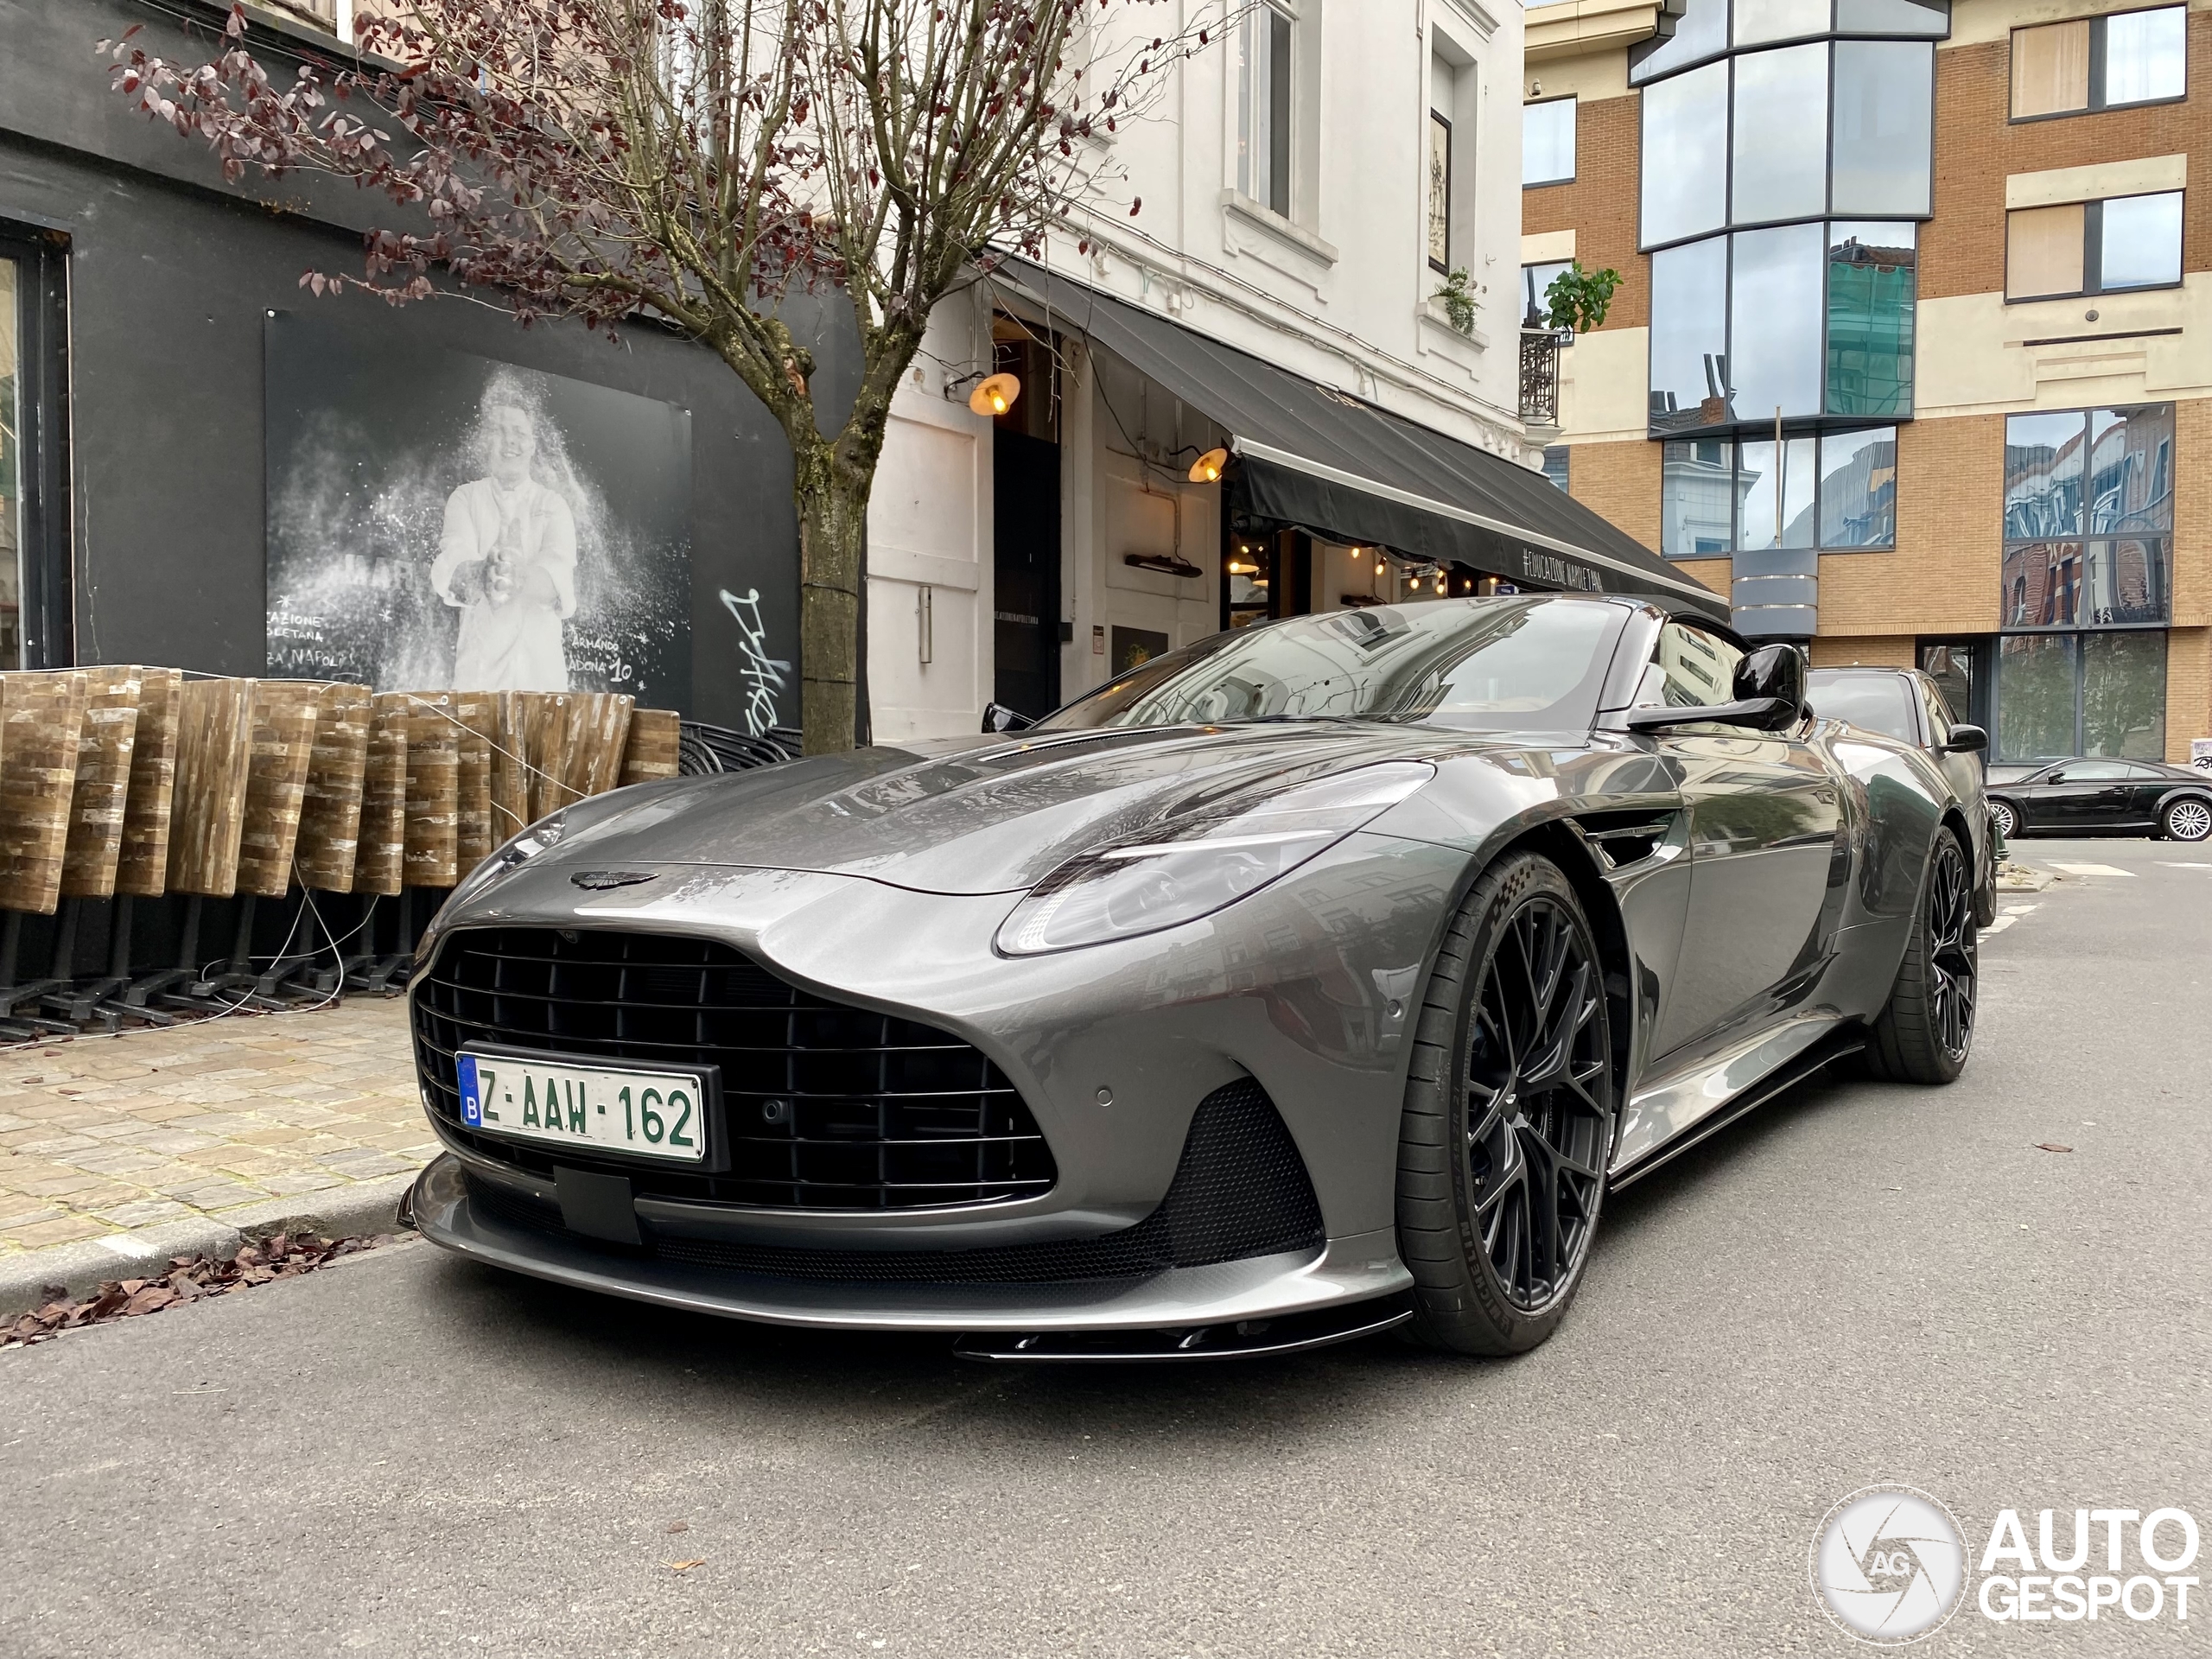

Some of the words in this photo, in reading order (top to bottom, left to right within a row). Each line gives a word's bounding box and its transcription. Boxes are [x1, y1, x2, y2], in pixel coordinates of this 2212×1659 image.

[1522, 547, 1567, 586] #EDUCAZIONE
[572, 632, 619, 652] ARMANDO
[608, 657, 632, 683] 10
[467, 1096, 479, 1121] B
[1459, 1221, 1502, 1322] MICHELIN
